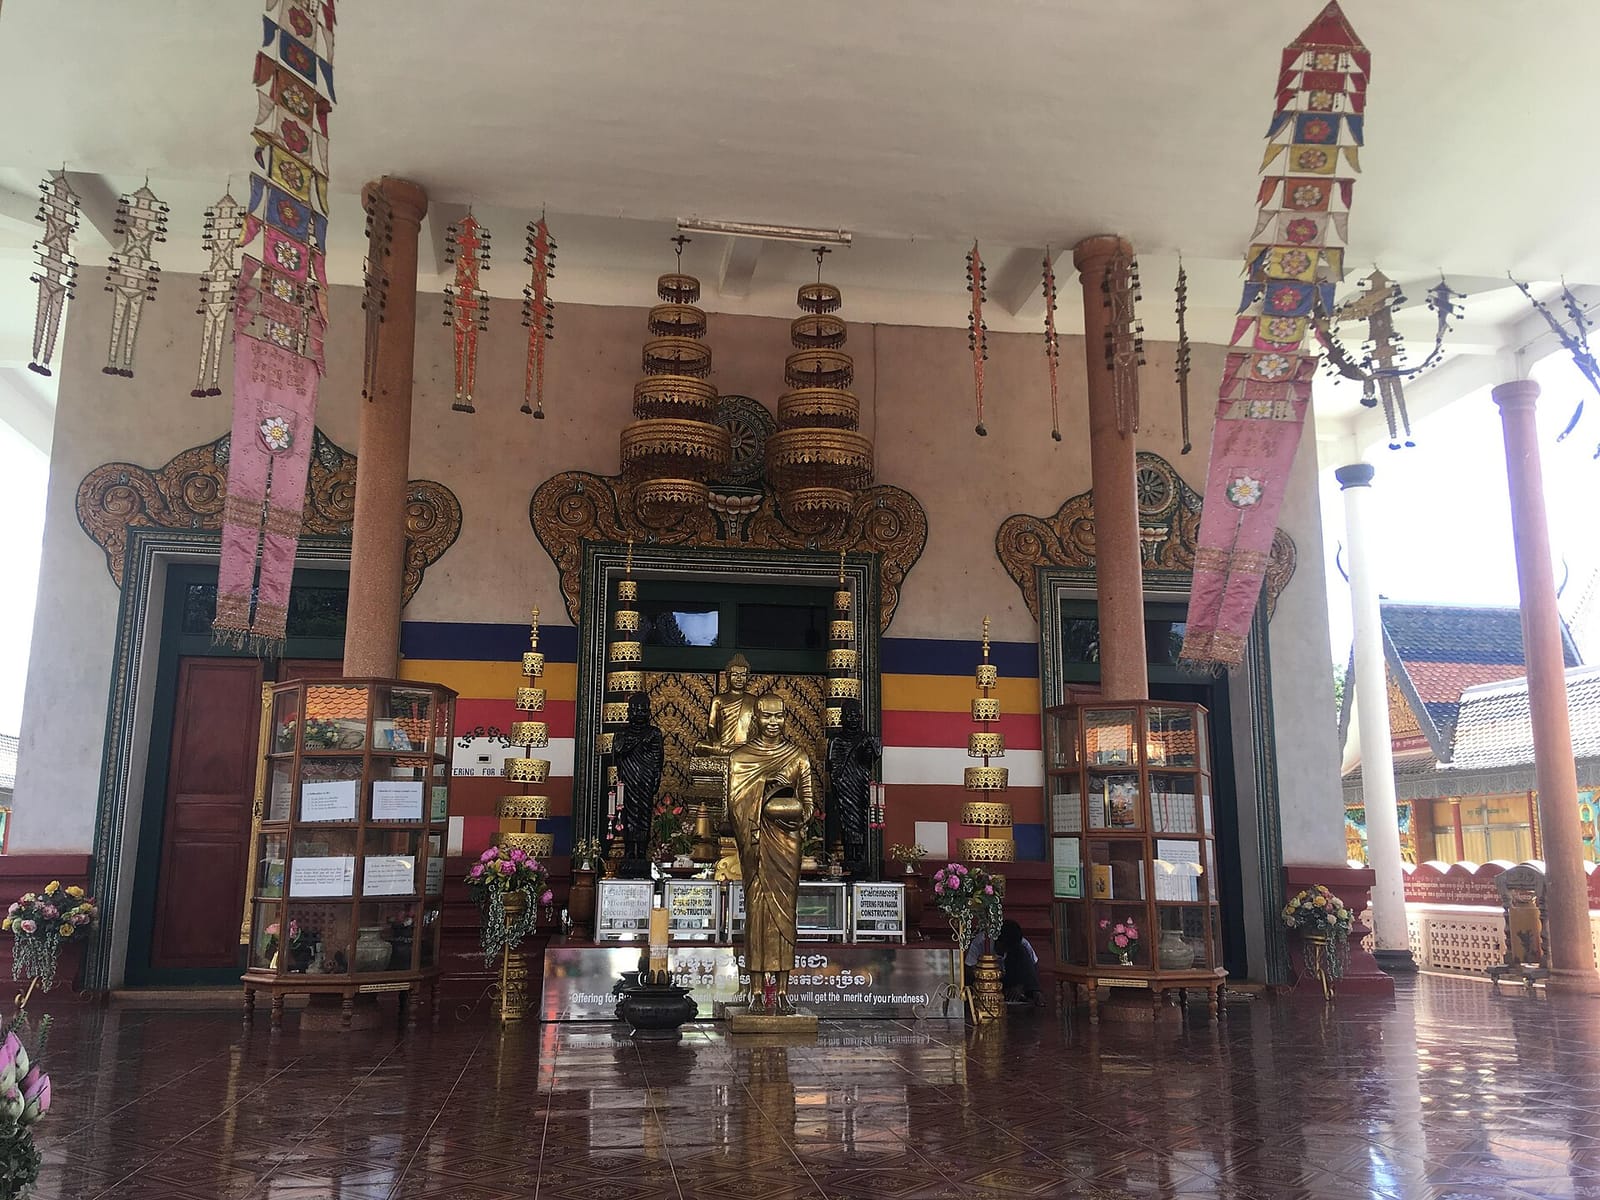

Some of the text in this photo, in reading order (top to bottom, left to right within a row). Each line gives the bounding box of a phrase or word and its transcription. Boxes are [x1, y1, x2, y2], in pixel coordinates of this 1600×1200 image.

[482, 767, 496, 776] FOR
[860, 909, 899, 918] CONSTRUCTION
[604, 992, 617, 1003] for
[801, 992, 814, 1002] will
[815, 993, 827, 1005] get
[828, 992, 840, 1002] the
[843, 992, 862, 1003] merit
[864, 992, 873, 1003] of
